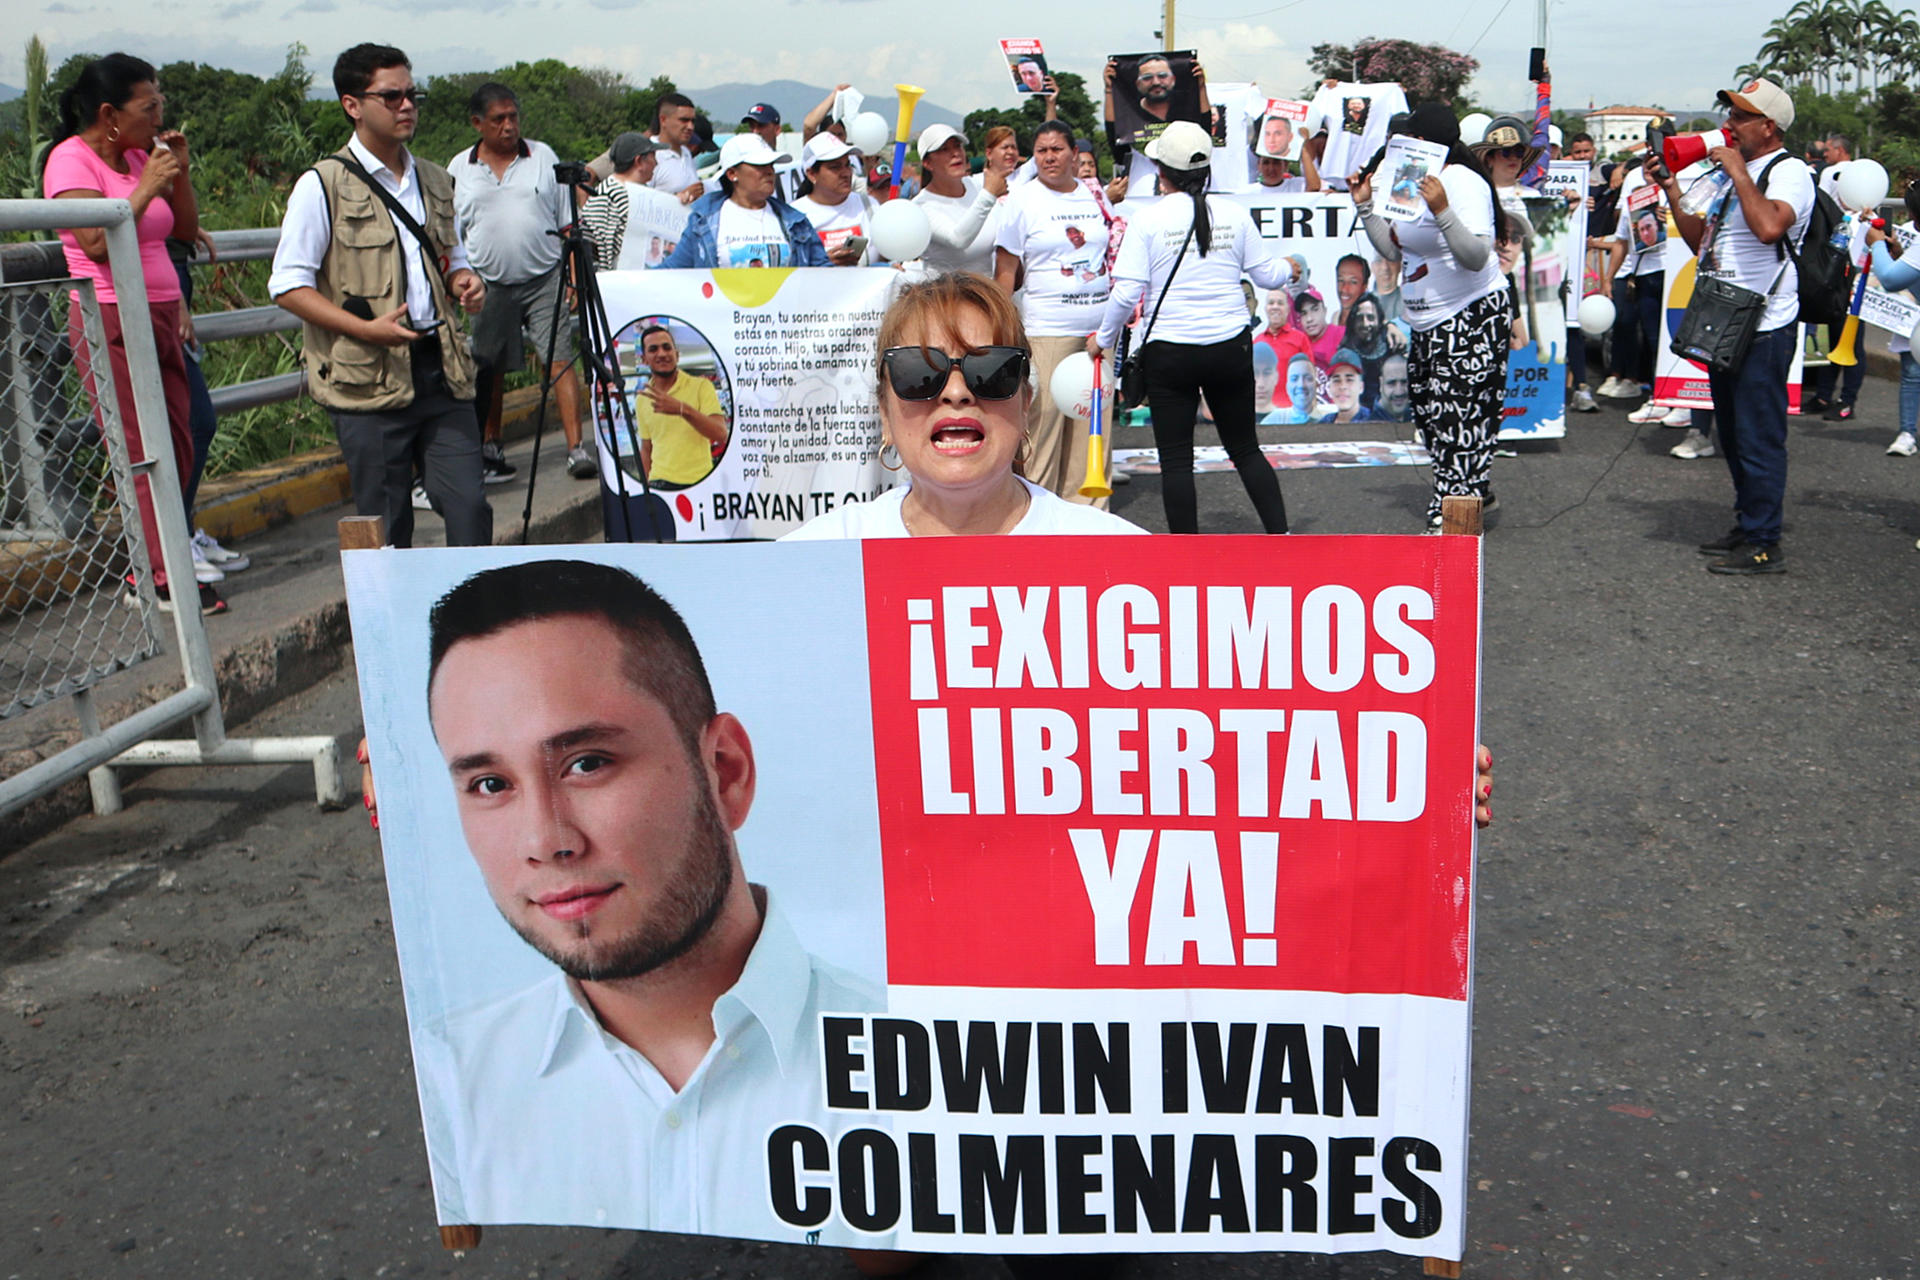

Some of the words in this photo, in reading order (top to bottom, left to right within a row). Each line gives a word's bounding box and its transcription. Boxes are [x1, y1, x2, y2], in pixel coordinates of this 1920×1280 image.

[733, 311, 775, 328] Brayan,
[778, 312, 789, 323] tu
[791, 310, 829, 323] sonrisa
[831, 312, 845, 323] en
[764, 330, 778, 340] en
[780, 327, 825, 340] nuestras
[735, 342, 781, 356] corazón.
[784, 341, 810, 359] Hijo,
[813, 343, 828, 354] tus
[831, 339, 870, 357] padres,
[735, 363, 742, 375] y
[758, 358, 798, 371] sobrina
[801, 360, 812, 370] te
[815, 358, 858, 370] amamos
[861, 360, 868, 372] y
[1514, 367, 1549, 382] POR
[736, 377, 758, 391] muy
[761, 373, 797, 386] fuerte.
[1522, 384, 1539, 398] de
[738, 405, 760, 417] Esta
[763, 403, 804, 417] marcha
[806, 407, 813, 419] y
[815, 404, 837, 415] esta
[840, 400, 869, 415] lucha
[739, 421, 791, 433] constante
[794, 418, 807, 432] de
[810, 418, 820, 431] la
[823, 416, 856, 431] fuerza
[858, 420, 876, 434] que
[740, 437, 767, 448] amor
[770, 440, 776, 452] y
[779, 435, 789, 448] la
[792, 432, 831, 446] unidad.
[834, 431, 863, 446] Cada
[741, 453, 758, 463] voz
[761, 453, 780, 468] que
[783, 449, 828, 464] alzamos,
[831, 451, 843, 461] es
[845, 451, 857, 461] un
[743, 468, 760, 481] por
[712, 492, 804, 522] BRAYAN
[810, 492, 835, 518] TE
[907, 584, 1436, 700] ¡EXIGIMOS
[917, 707, 1428, 822] LIBERTAD
[1068, 829, 1280, 966] YA!
[822, 1015, 1132, 1116] EDWIN
[1160, 1020, 1381, 1118] IVAN
[766, 1125, 1443, 1240] COLMENARES
